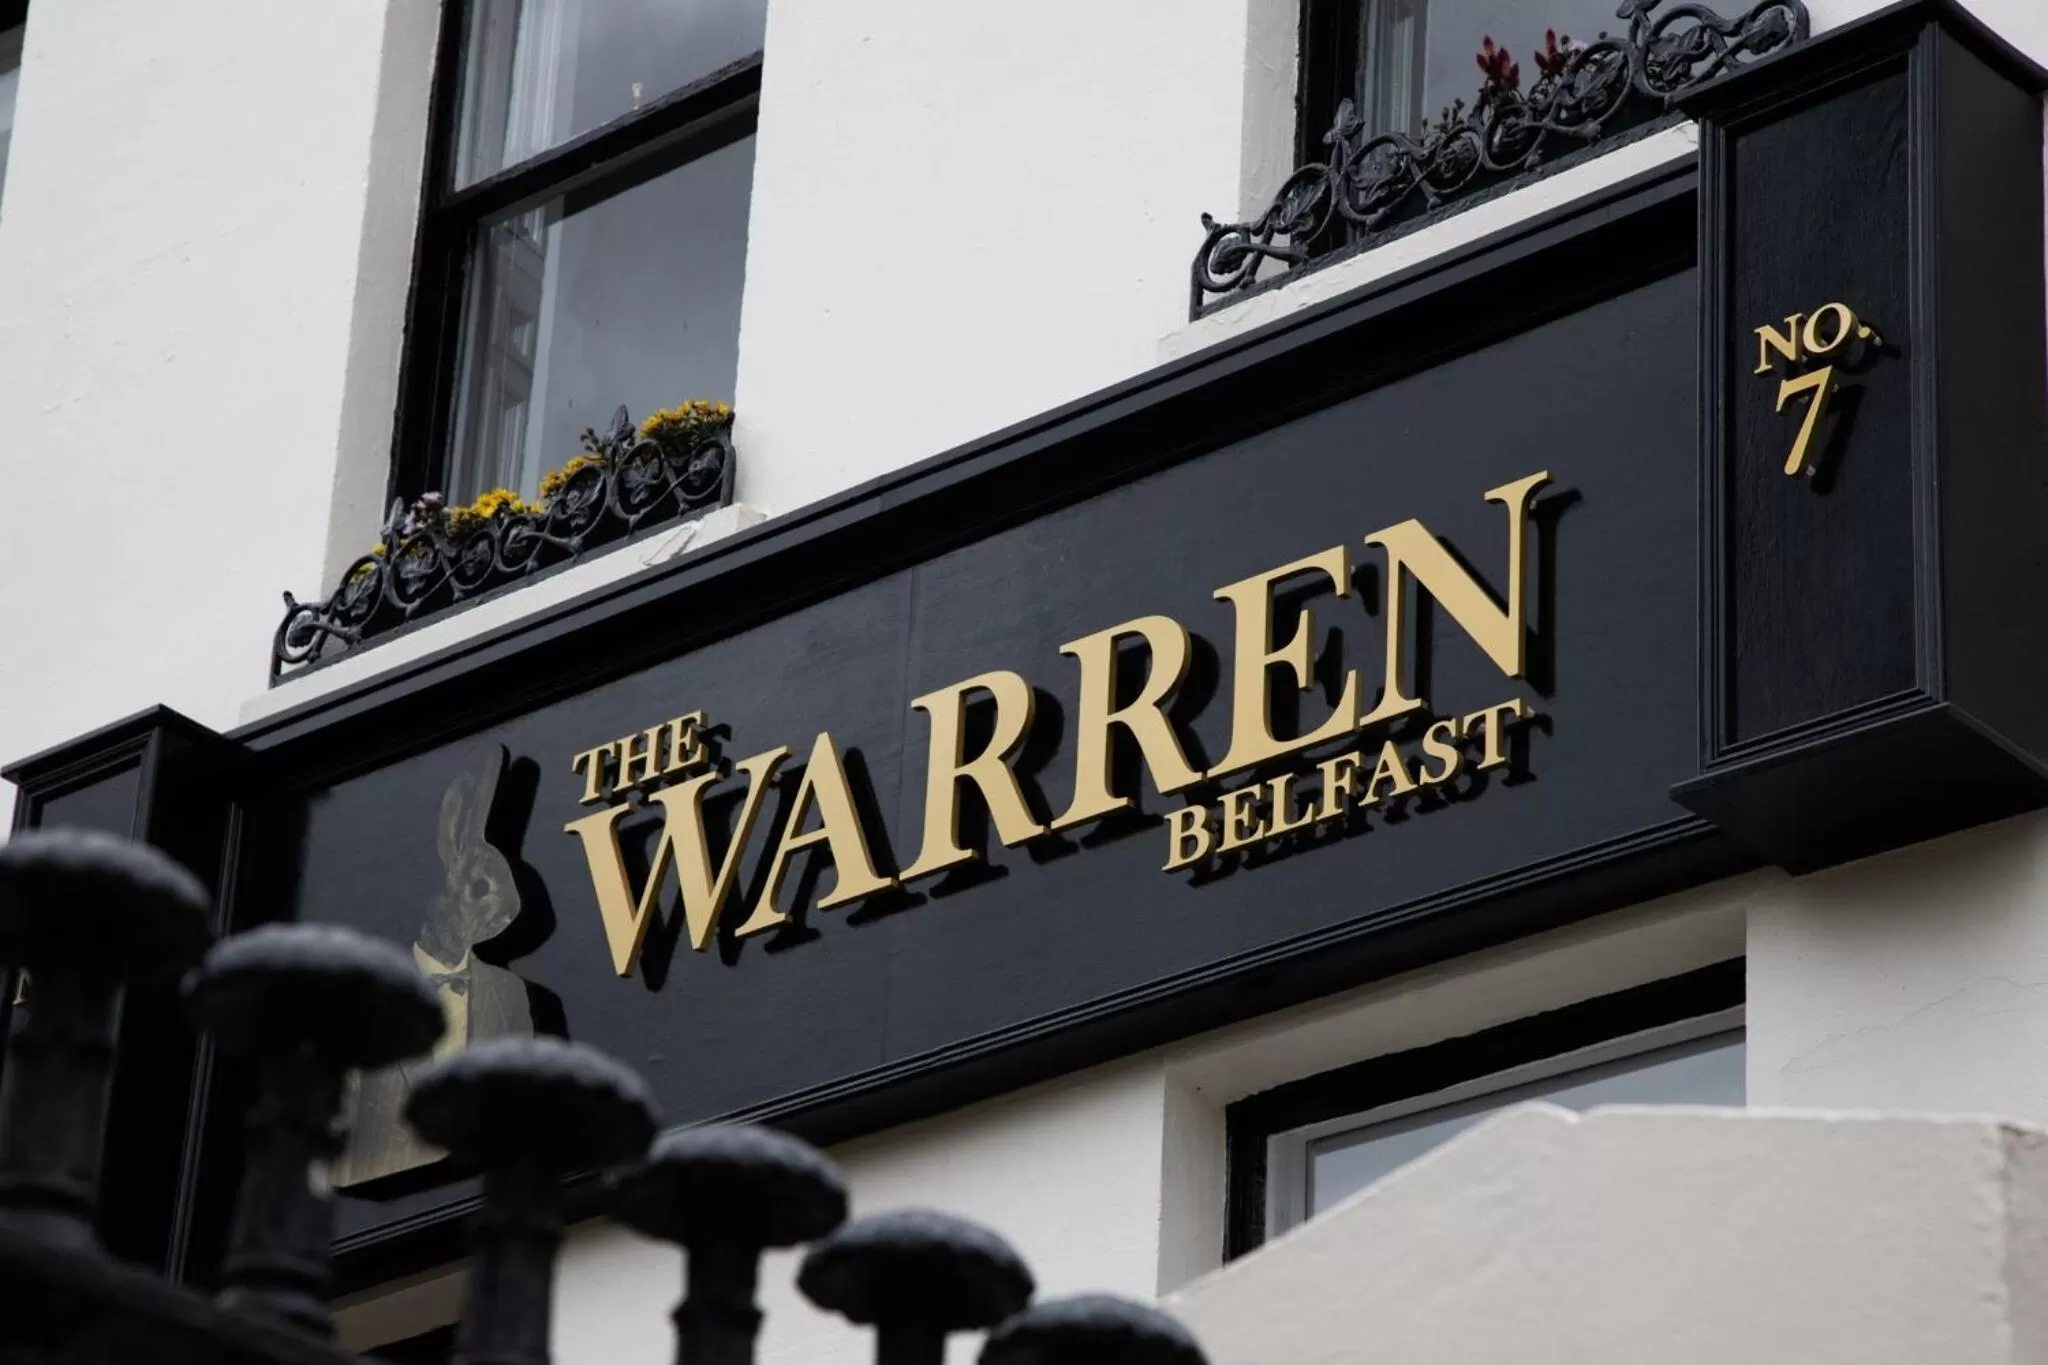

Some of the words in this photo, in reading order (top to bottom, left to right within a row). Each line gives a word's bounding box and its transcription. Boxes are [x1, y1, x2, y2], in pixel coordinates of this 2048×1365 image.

[1753, 302, 1872, 375] NO.
[1775, 365, 1833, 477] 7
[564, 469, 1551, 977] WARREN
[571, 708, 709, 806] THE
[1162, 697, 1532, 874] BELFAST
